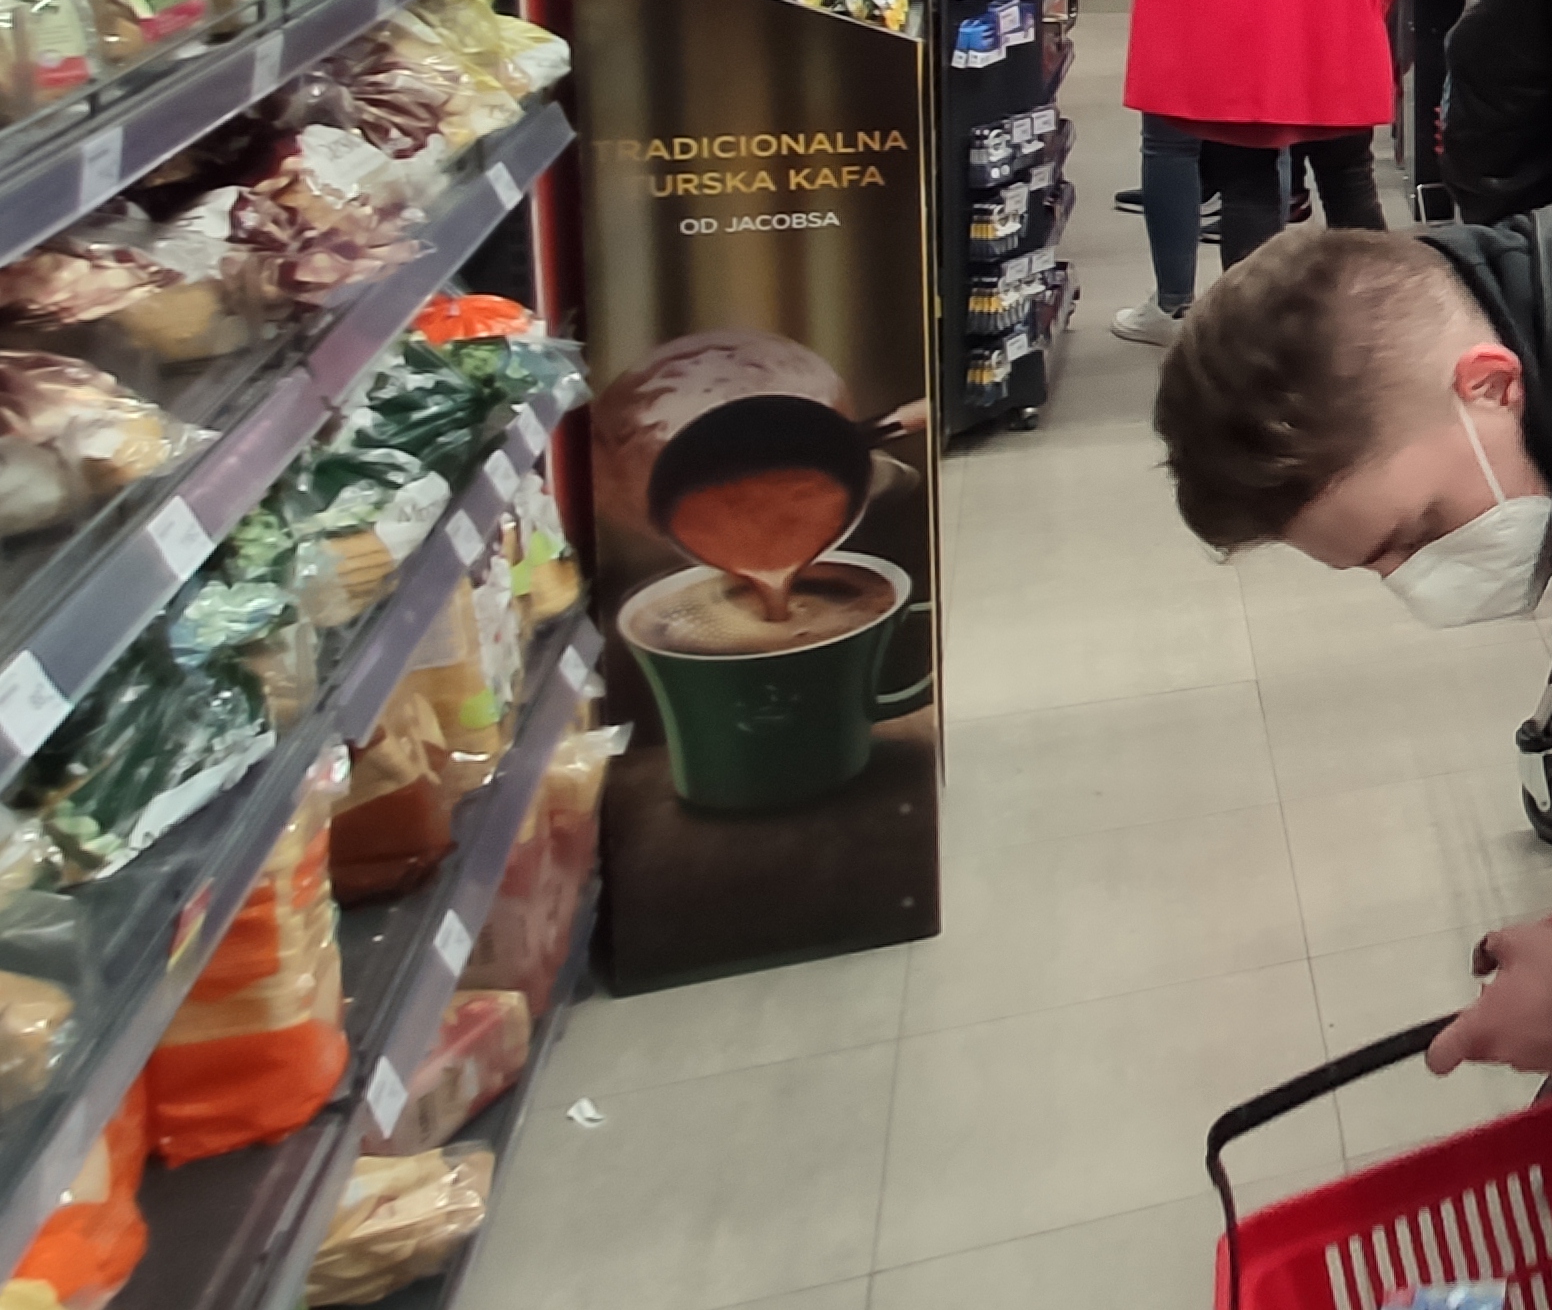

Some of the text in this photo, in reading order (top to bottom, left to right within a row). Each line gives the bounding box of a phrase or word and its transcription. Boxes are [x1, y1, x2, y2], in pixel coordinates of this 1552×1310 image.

[788, 165, 886, 191] KAFA
[679, 211, 841, 236] OD JACOBSA
